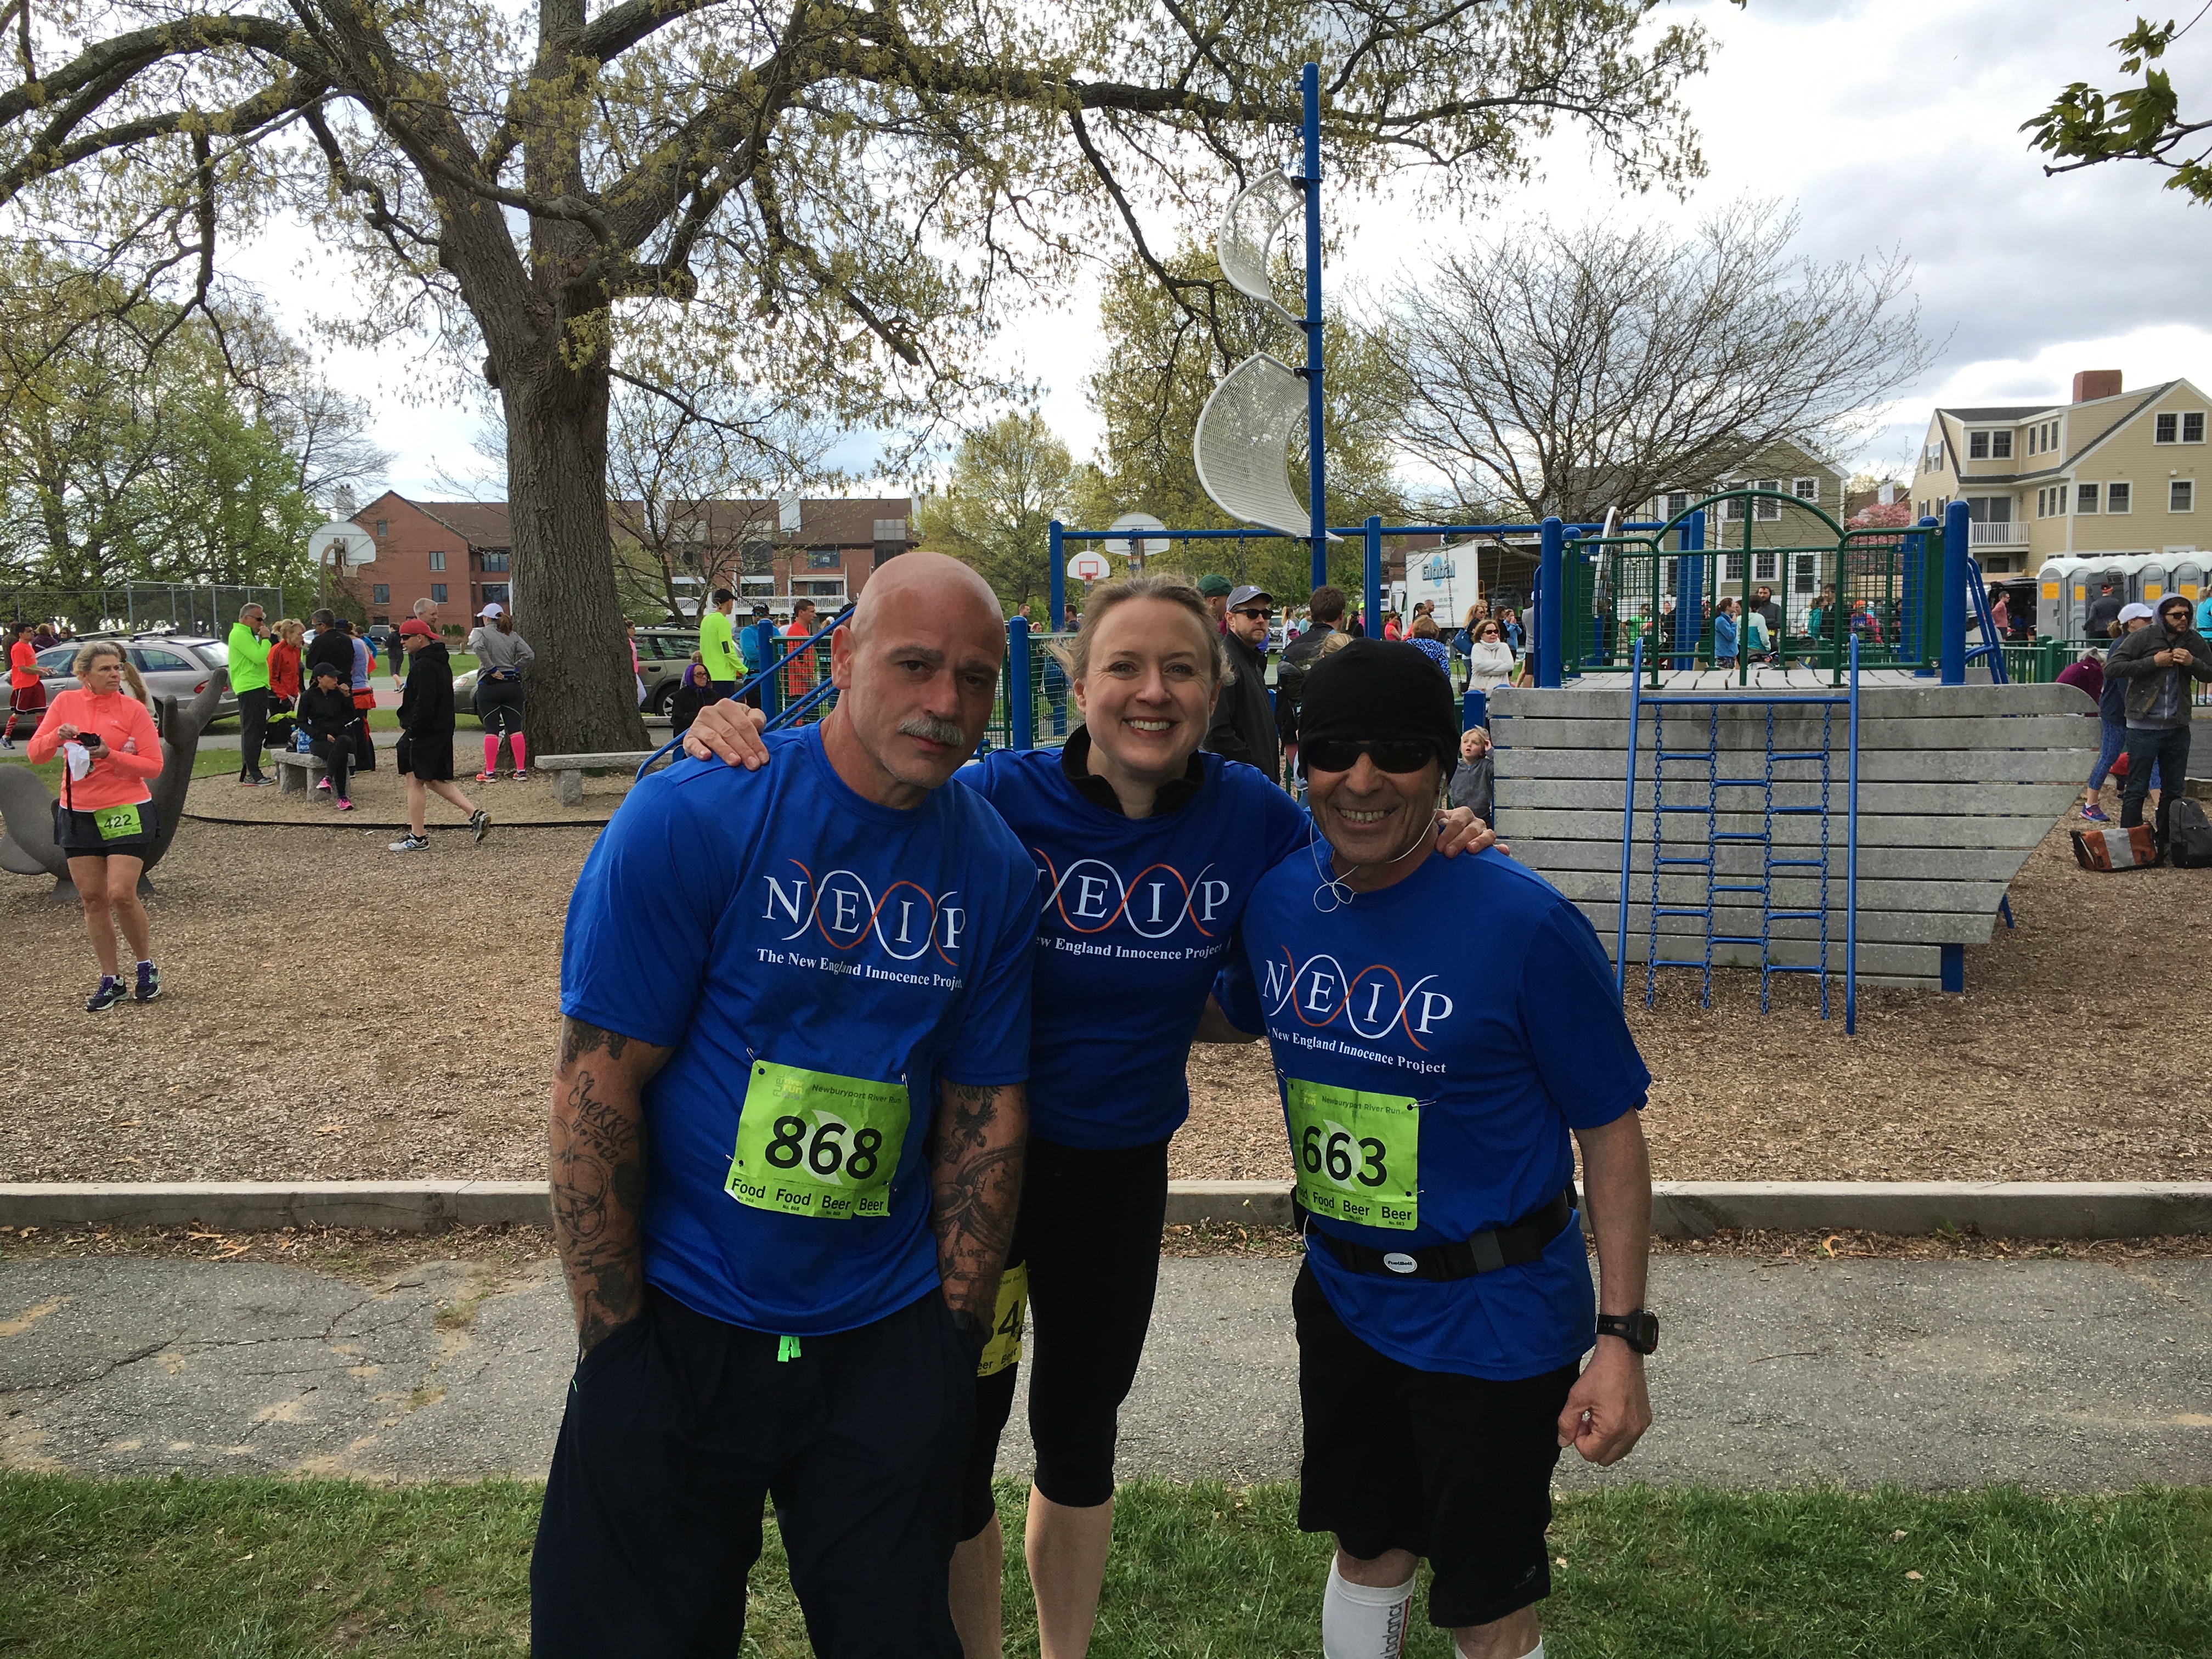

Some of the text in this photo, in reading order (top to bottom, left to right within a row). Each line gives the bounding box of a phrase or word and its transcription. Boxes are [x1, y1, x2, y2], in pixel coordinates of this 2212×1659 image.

[1422, 560, 1456, 581] Global
[104, 814, 132, 829] 422
[761, 876, 966, 949] NEIP
[1054, 937, 1112, 956] England
[1115, 945, 1182, 960] Innocence
[1184, 943, 1223, 960] Project
[757, 948, 785, 965] The
[788, 952, 817, 969] New
[820, 956, 861, 976] England
[865, 965, 930, 986] Innocence
[1262, 959, 1454, 1034] NEIP
[1272, 1026, 1447, 1074] New England Innocence Project
[811, 1084, 866, 1099] Newburyport
[867, 1093, 888, 1103] River
[888, 1096, 902, 1104] Run
[1322, 1095, 1362, 1110] Newburyport
[1364, 1103, 1384, 1113] River
[1385, 1107, 1401, 1115] Run
[765, 1115, 883, 1180] 868
[1302, 1125, 1387, 1187] 663
[731, 1178, 766, 1199] Food
[775, 1188, 812, 1206] Food
[822, 1195, 851, 1211] Beer
[859, 1198, 884, 1211] Beer
[1313, 1191, 1335, 1209] Food
[1342, 1199, 1370, 1217] Beer
[1381, 1206, 1412, 1221] Beer
[978, 1361, 994, 1371] eer
[1001, 1347, 1018, 1365] Beer
